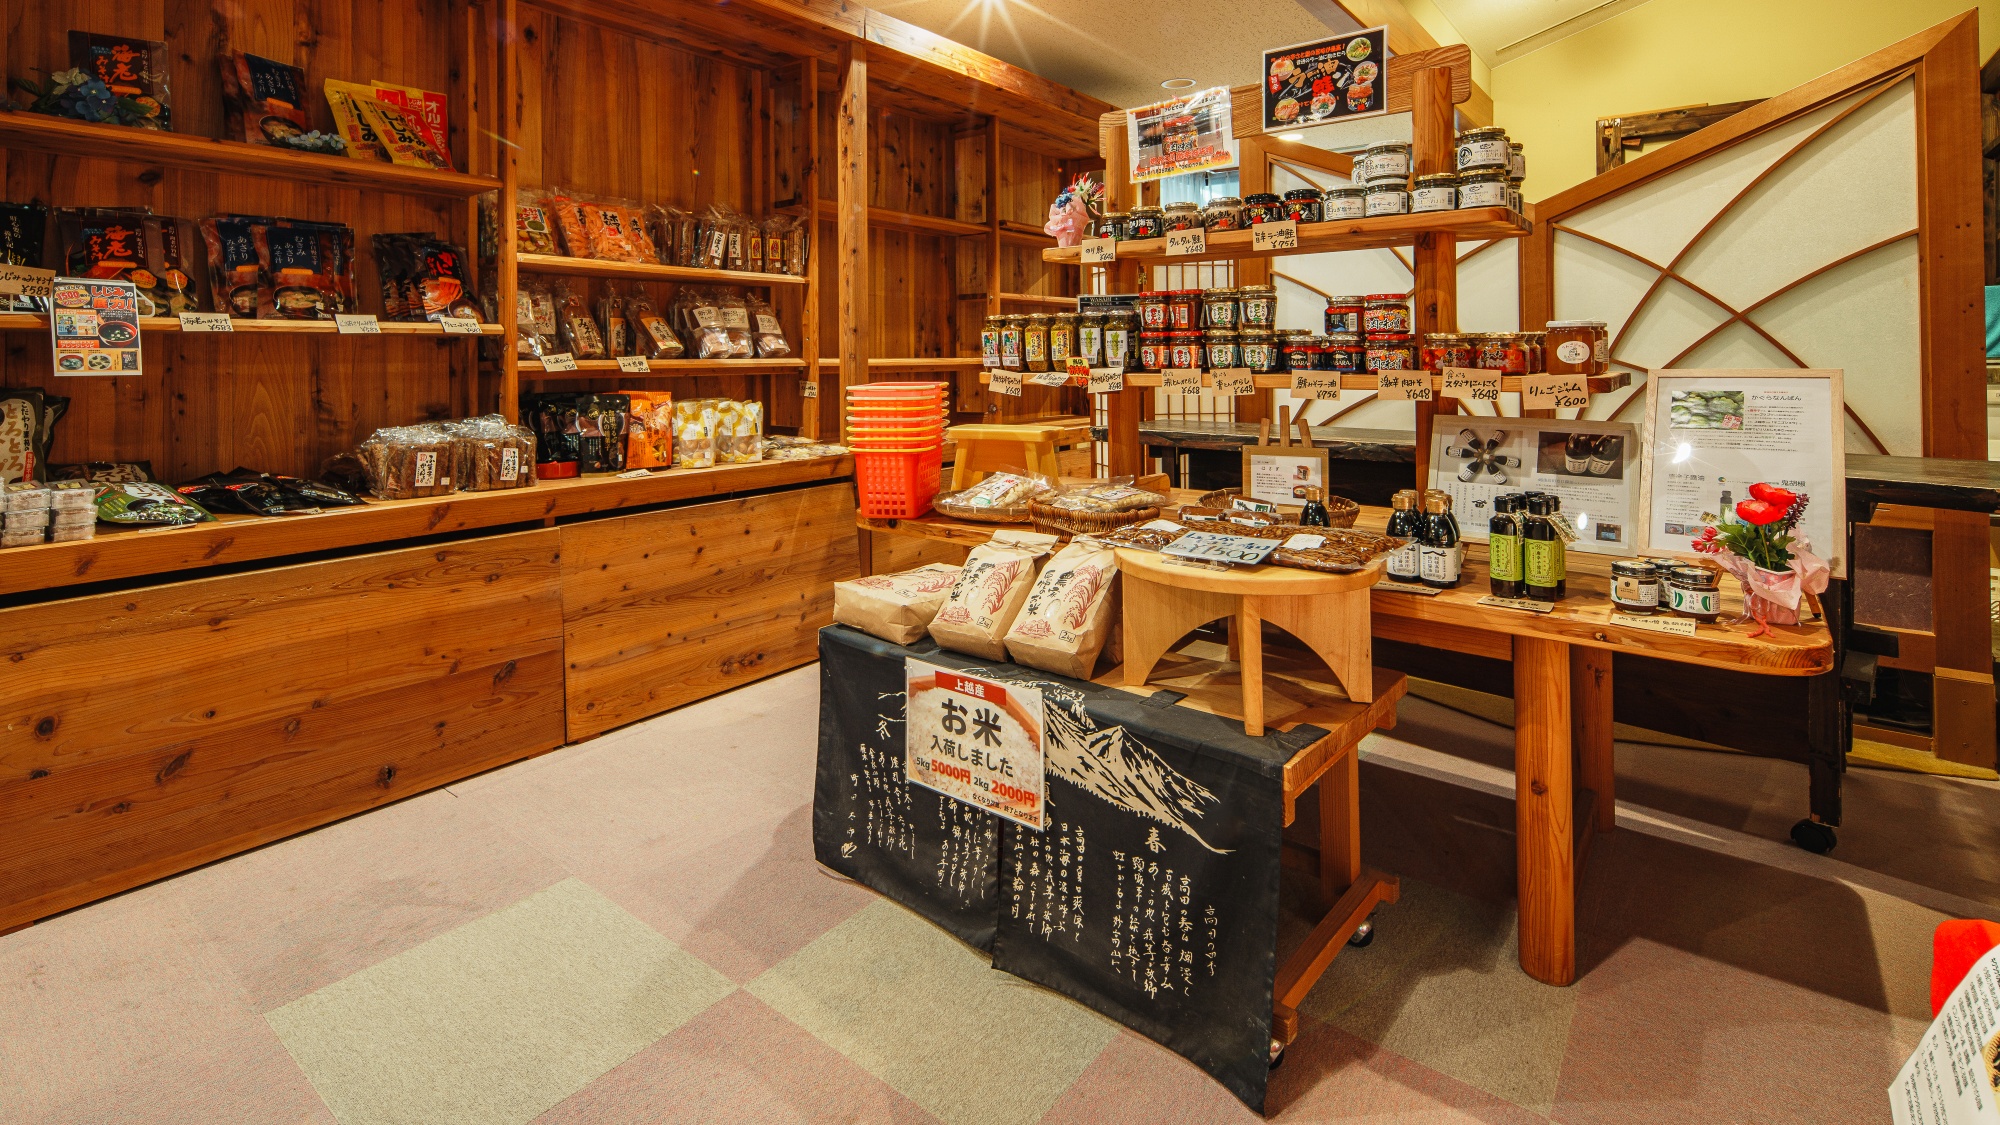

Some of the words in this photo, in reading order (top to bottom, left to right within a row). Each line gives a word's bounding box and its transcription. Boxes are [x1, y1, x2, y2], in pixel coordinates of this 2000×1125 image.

[110, 44, 141, 82] 海老
[104, 225, 134, 259] 海老
[1168, 234, 1202, 248] タルタル鮭
[1270, 239, 1295, 249] ¥756
[1185, 243, 1204, 253] ¥648
[21, 285, 50, 296] ¥583
[1108, 382, 1122, 390] ¥648
[1233, 385, 1253, 395] ¥648
[1445, 380, 1498, 388] スタミナにんにく
[1529, 382, 1583, 396] りんごジャム
[1005, 386, 1021, 395] ¥648
[1182, 386, 1200, 395] ¥648
[1316, 391, 1337, 399] ¥756
[1406, 388, 1431, 400] ¥648
[1471, 388, 1499, 400] ¥648
[1554, 397, 1587, 407] ¥600
[978, 616, 992, 628] 2kg
[1060, 631, 1075, 642] 2kg
[954, 679, 985, 698] 上越産
[941, 698, 1002, 748] お米
[931, 734, 1014, 778] 入荷しました
[916, 756, 931, 771] 5kg
[931, 758, 971, 785] 5000円
[973, 776, 989, 792] 2kg
[991, 779, 1035, 808] 2000円
[972, 792, 1038, 823] なくなり次第、終了となります
[1146, 826, 1167, 853] 春
